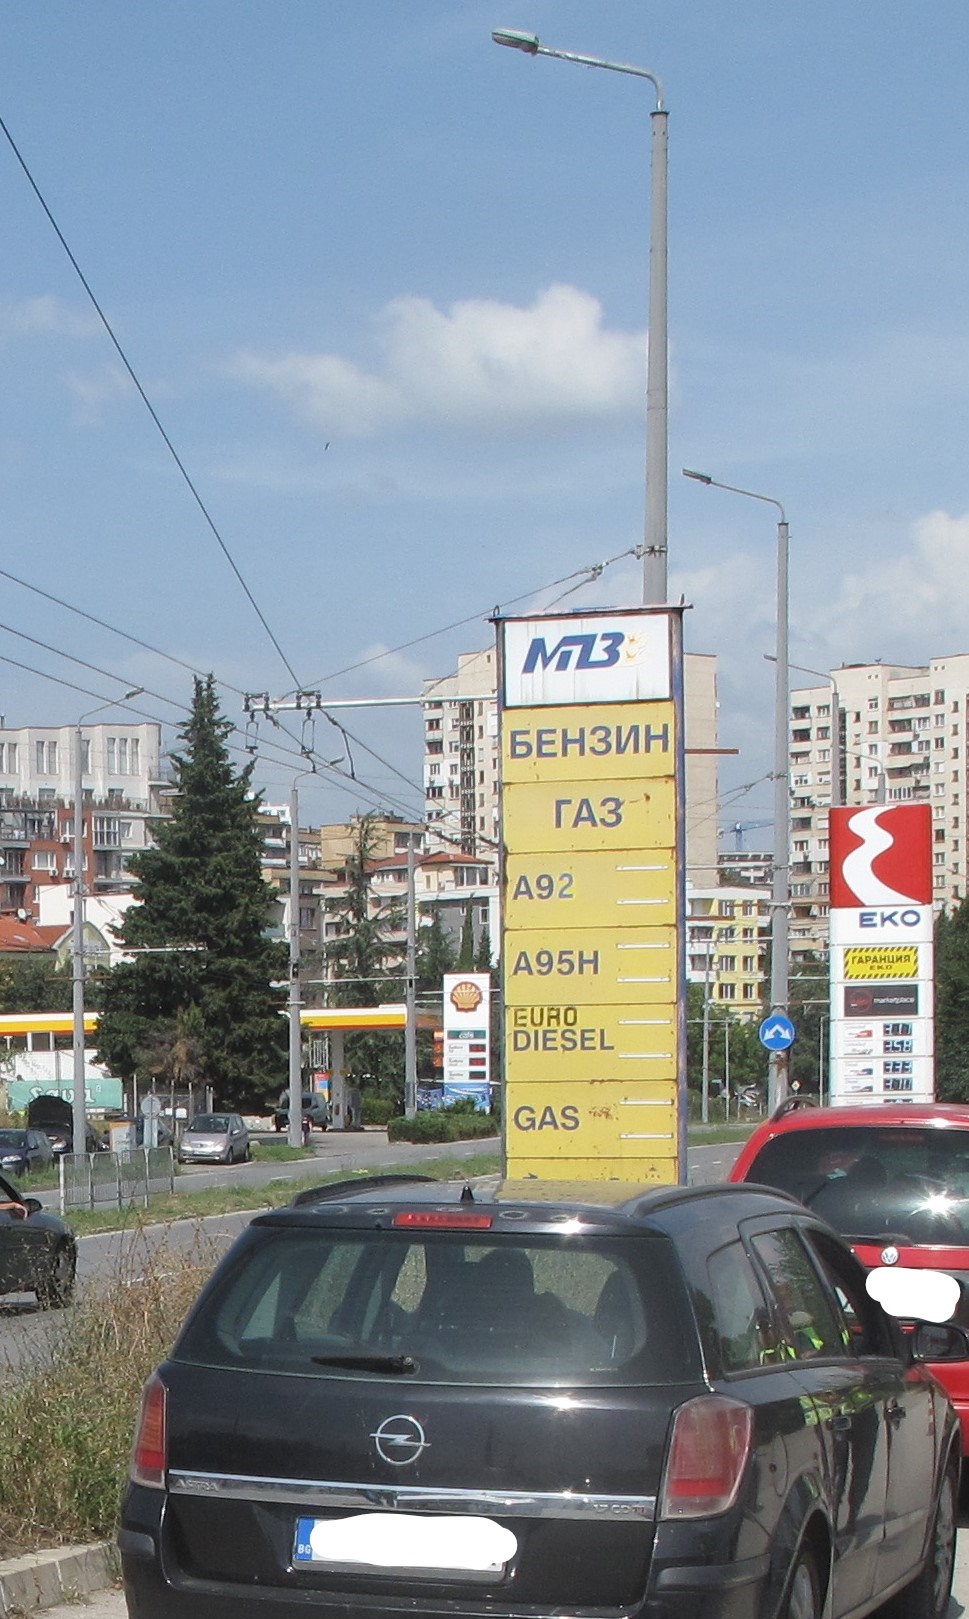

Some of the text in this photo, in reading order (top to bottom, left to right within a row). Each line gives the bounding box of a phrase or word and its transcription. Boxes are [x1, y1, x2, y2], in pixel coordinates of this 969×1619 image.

[509, 723, 670, 760] БЕНЗИН
[554, 796, 624, 829] ГАЗ
[859, 909, 921, 929] EKO
[851, 954, 911, 965] ГАРАНЦИЯ
[513, 1006, 578, 1028] EURO
[512, 1028, 615, 1052] DIESEL
[513, 1105, 580, 1132] GAS
[298, 1543, 311, 1554] BG
